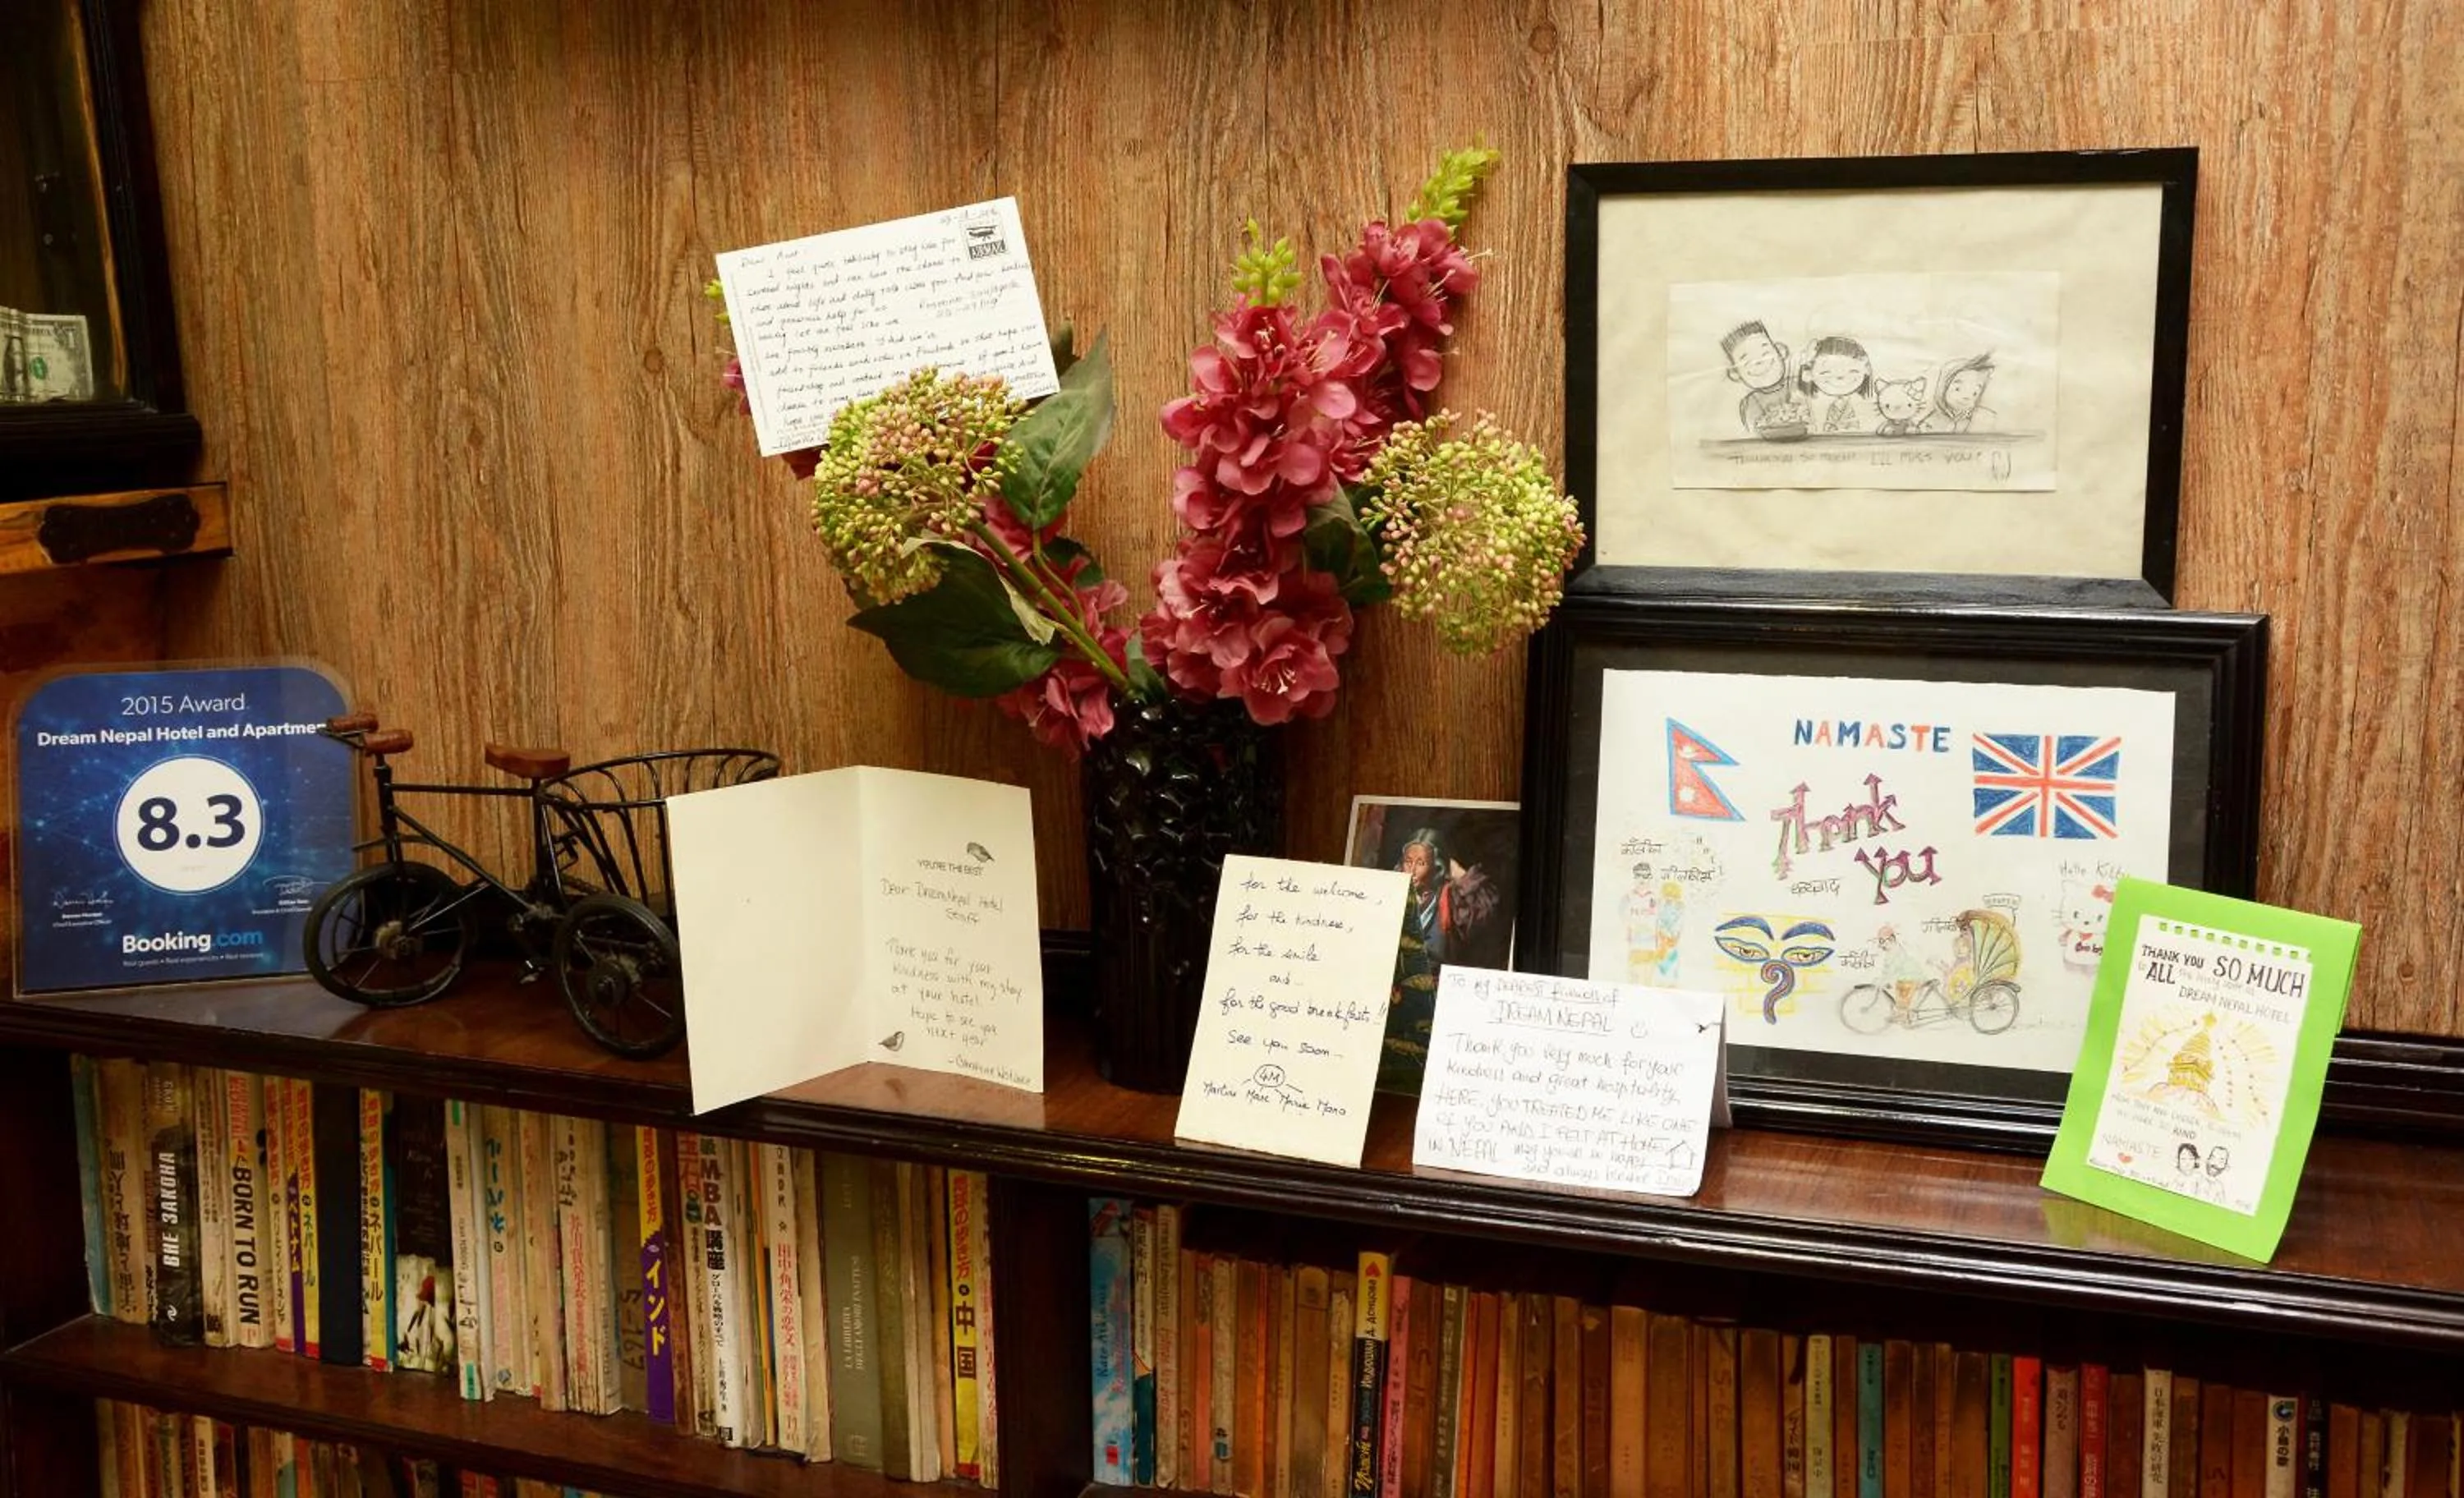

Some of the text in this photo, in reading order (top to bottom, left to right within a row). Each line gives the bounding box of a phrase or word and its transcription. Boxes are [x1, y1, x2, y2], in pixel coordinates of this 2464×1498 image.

[122, 692, 246, 716] 2015 Award
[37, 731, 97, 747] Dream
[100, 728, 153, 746] Nepal
[156, 725, 204, 741] Hotel
[206, 724, 239, 739] and
[1793, 717, 1951, 753] NAMASTE
[136, 793, 246, 852] 8.3
[1770, 772, 1907, 881] Thank
[948, 862, 963, 874] THE
[1277, 874, 1301, 894] the
[122, 930, 263, 953] Booking.com
[1280, 942, 1322, 963] smile
[2141, 944, 2180, 963] THANK
[2183, 953, 2205, 969] YOU
[2213, 954, 2242, 982] SO
[2246, 963, 2305, 999] MUCH
[2145, 961, 2177, 986] ALL
[2178, 984, 2290, 1024] DREAM NEPAL HOTEL
[1227, 1028, 1252, 1045] See
[159, 1151, 180, 1268] ВНЕ ЗАКОНА
[232, 1165, 256, 1232] BORN
[235, 1235, 258, 1271] TO
[368, 1207, 384, 1303] ネパール
[237, 1279, 260, 1326] RUN
[646, 1258, 665, 1357] インド
[954, 1300, 977, 1381] 中国
